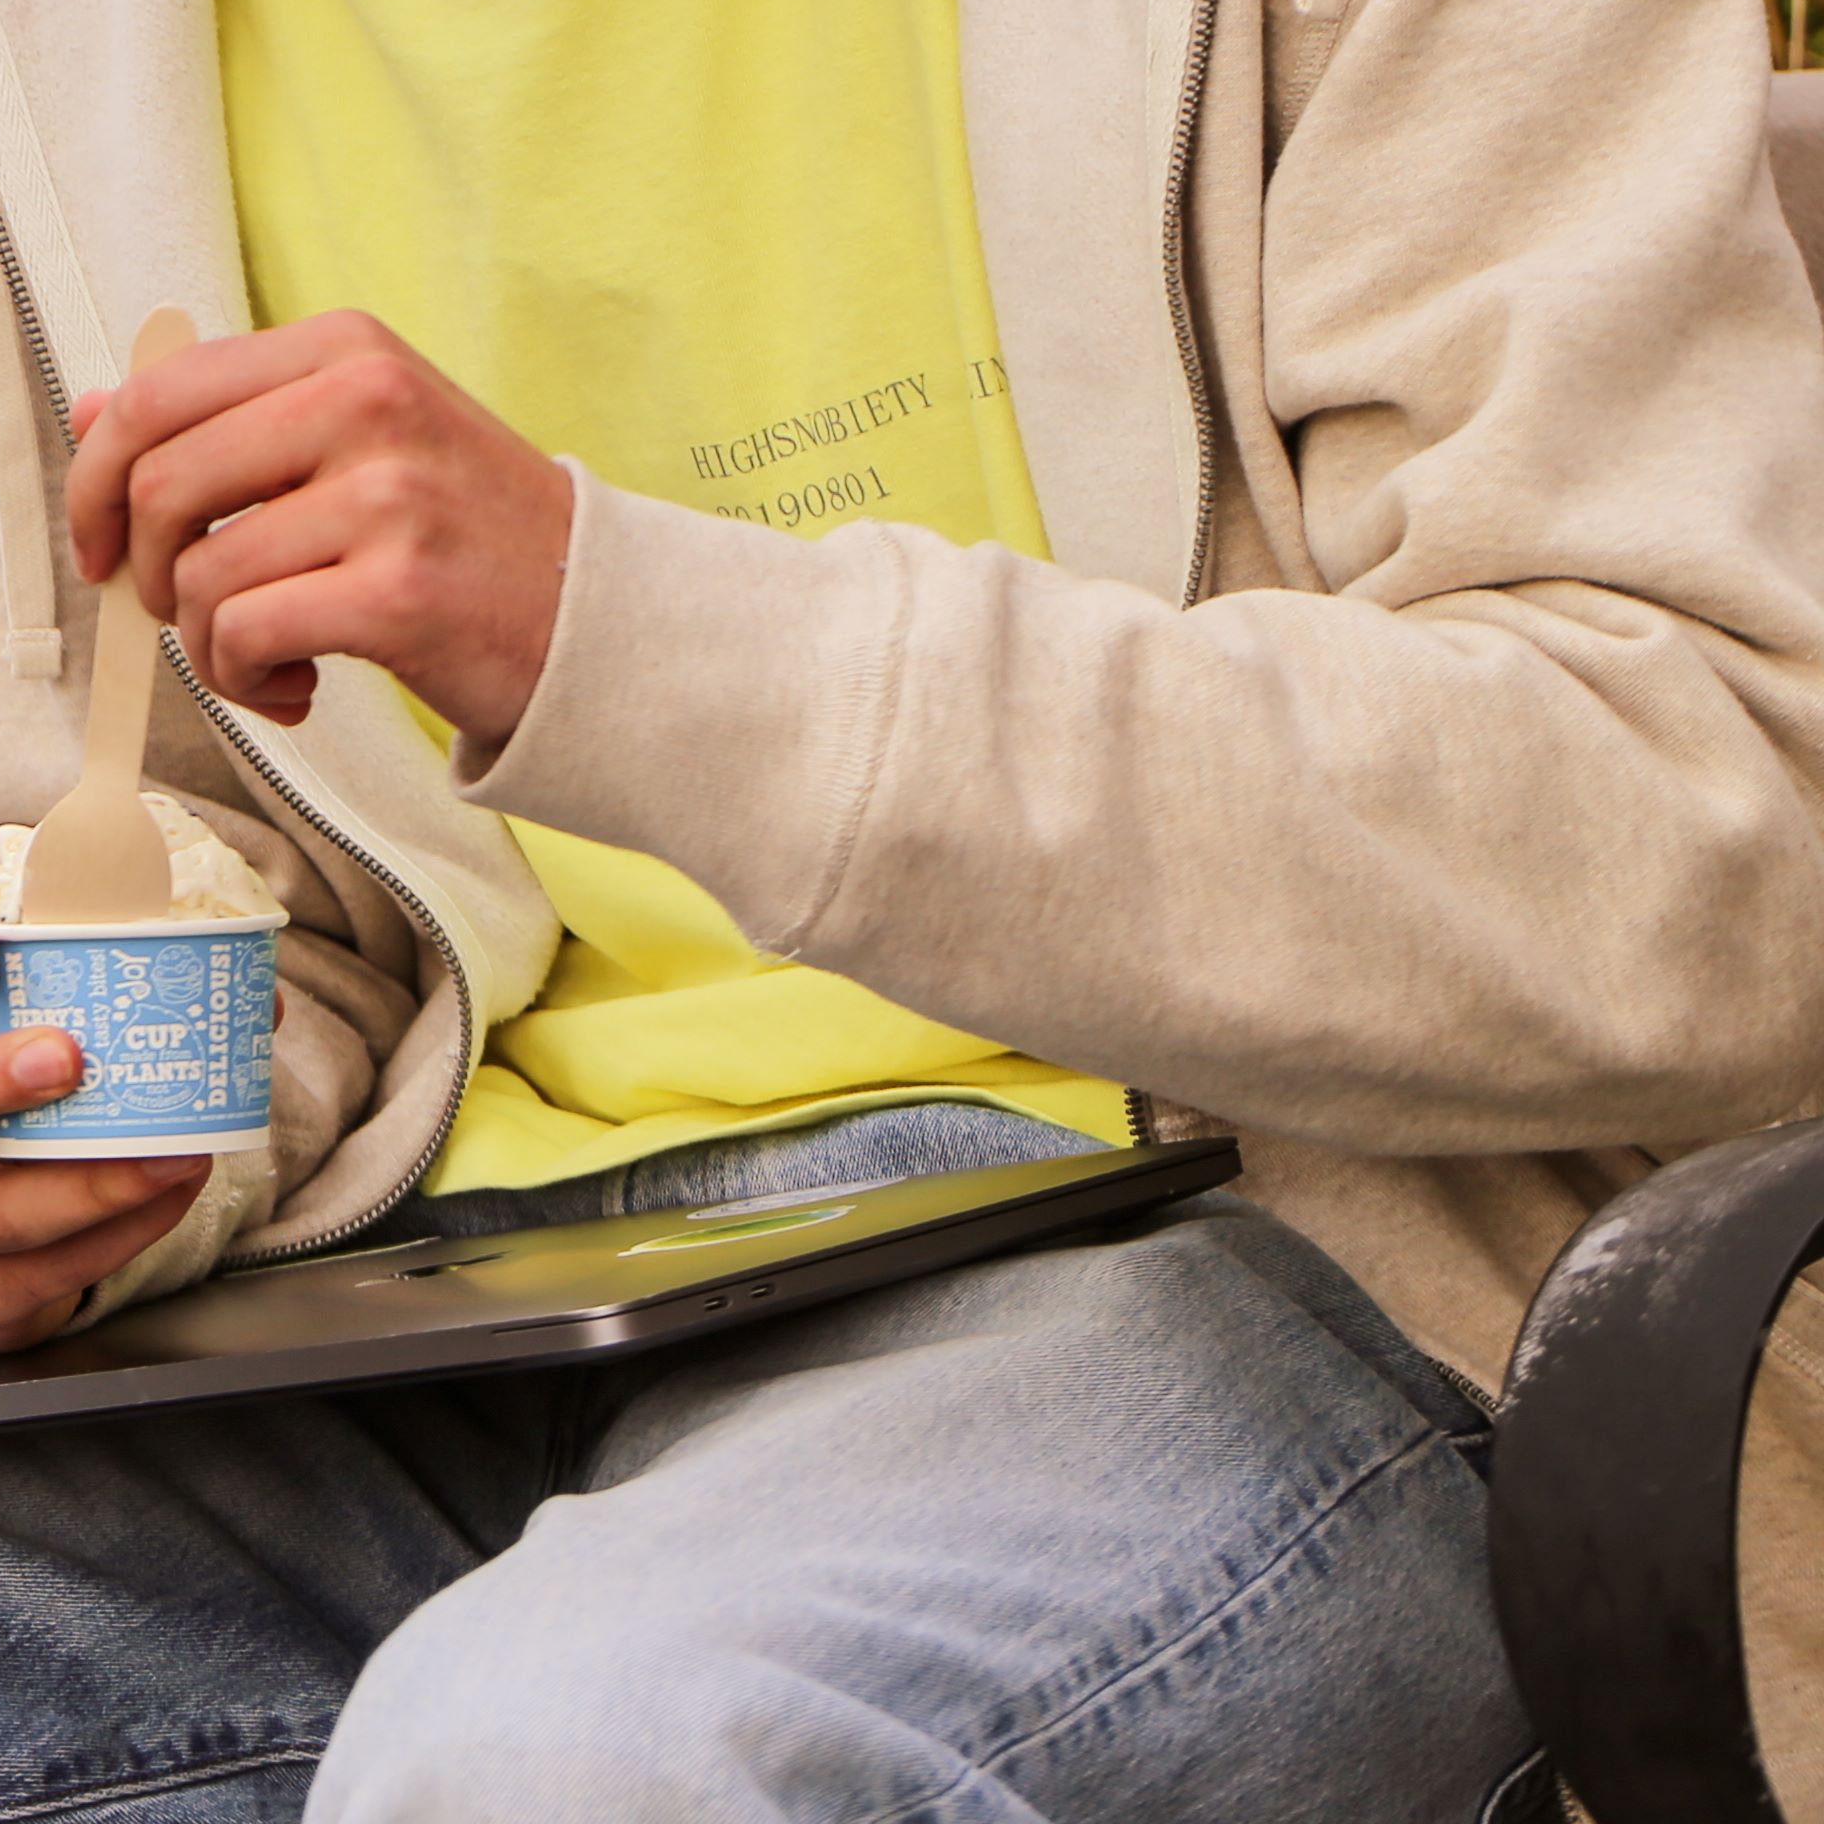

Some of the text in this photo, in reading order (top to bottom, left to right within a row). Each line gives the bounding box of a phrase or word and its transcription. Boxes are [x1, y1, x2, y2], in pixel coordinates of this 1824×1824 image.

[689, 372, 934, 480] HIGHSNOBIETY
[4, 952, 28, 1008] BEN
[110, 948, 151, 1001] JOY
[91, 1003, 111, 1048] tasty
[125, 1023, 188, 1051] CUP
[208, 943, 231, 1107] DELICIOUS!
[109, 1060, 202, 1085] PLANTS
